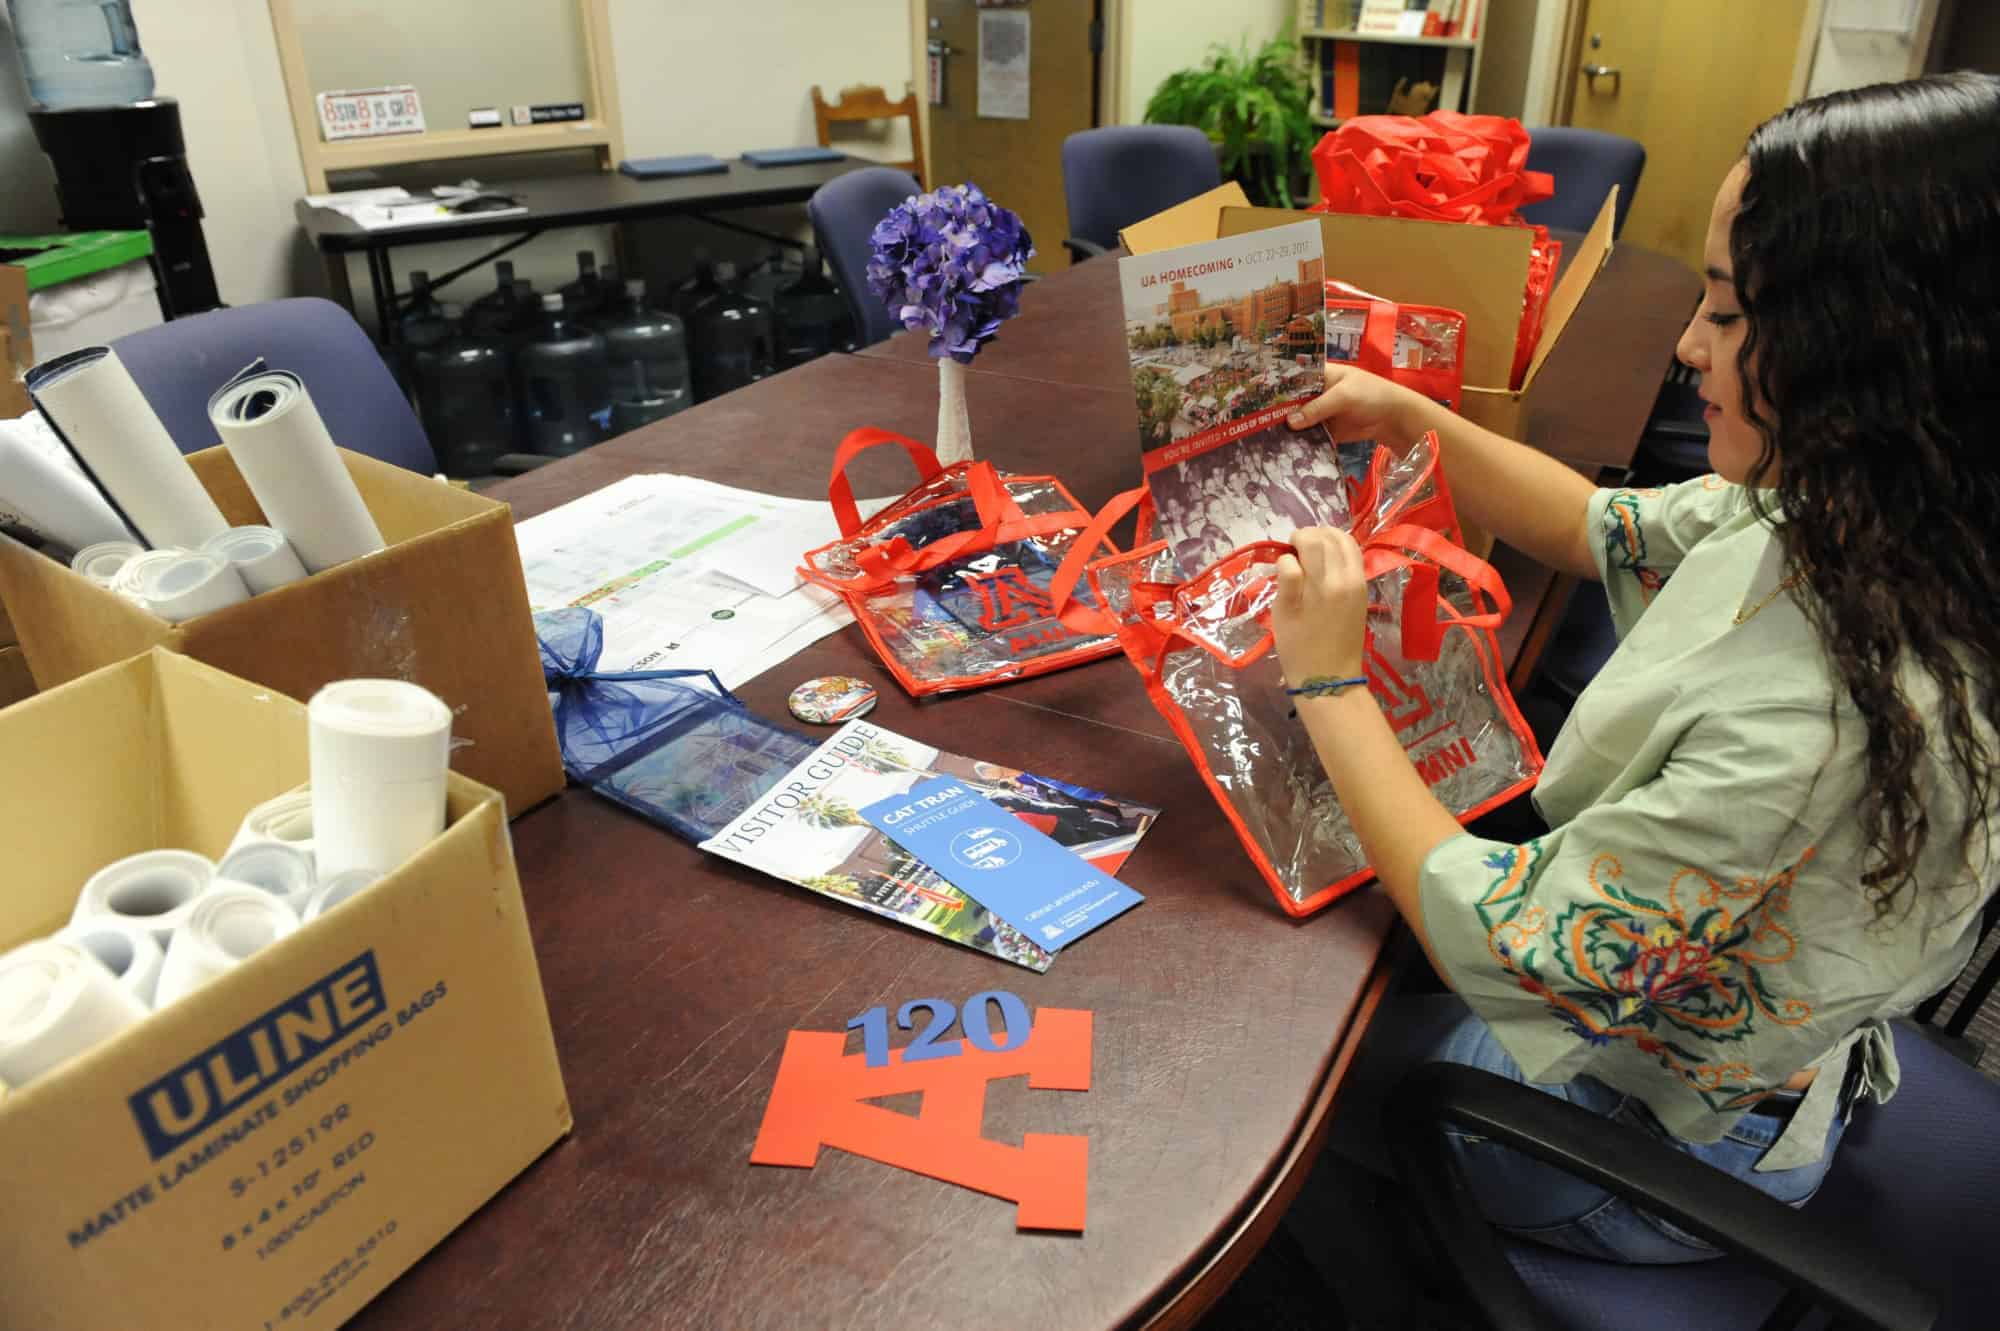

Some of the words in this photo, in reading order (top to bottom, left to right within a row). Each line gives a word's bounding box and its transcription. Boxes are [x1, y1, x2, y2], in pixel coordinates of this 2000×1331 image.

[1141, 275, 1157, 287] UA
[1160, 258, 1234, 283] HOMECOMING
[715, 780, 817, 853] VISITOR
[807, 724, 879, 780] GUIDE
[883, 804, 916, 824] CAT
[915, 785, 964, 808] TRAN
[149, 963, 377, 1136] ULINE
[847, 991, 1033, 1069] 120
[66, 1183, 156, 1249] MATTE
[157, 1100, 280, 1190] LAMINATE
[281, 1021, 394, 1107] SHOPPING
[396, 979, 448, 1027] BAGS
[332, 1131, 374, 1168] RED
[750, 1007, 1094, 1232] A
